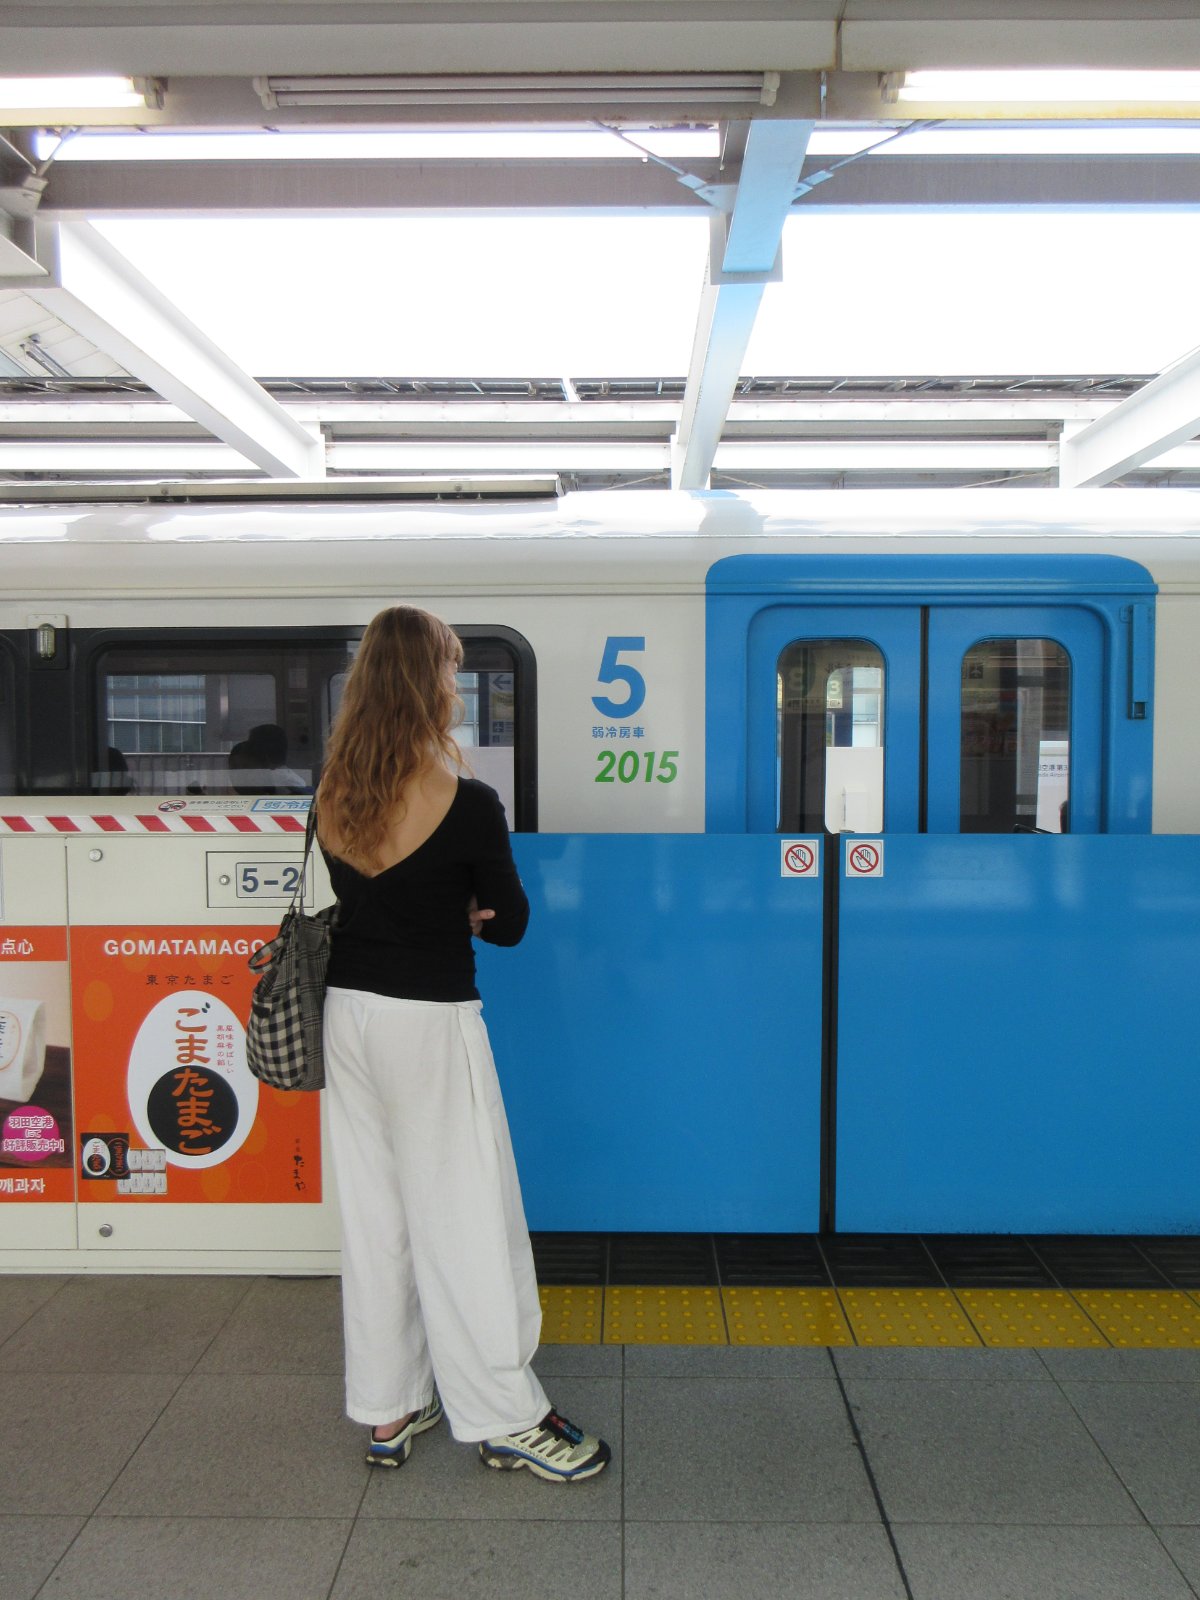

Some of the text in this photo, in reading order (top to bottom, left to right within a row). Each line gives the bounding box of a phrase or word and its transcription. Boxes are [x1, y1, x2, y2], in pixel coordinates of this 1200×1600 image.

[591, 636, 646, 719] 5
[591, 726, 645, 739] 弱冷房車
[594, 750, 680, 784] 2015
[1, 937, 34, 955] 点心
[146, 974, 234, 986] 東京たまご
[171, 1002, 222, 1155] ごまたまご
[9, 1116, 54, 1128] 羽田空港
